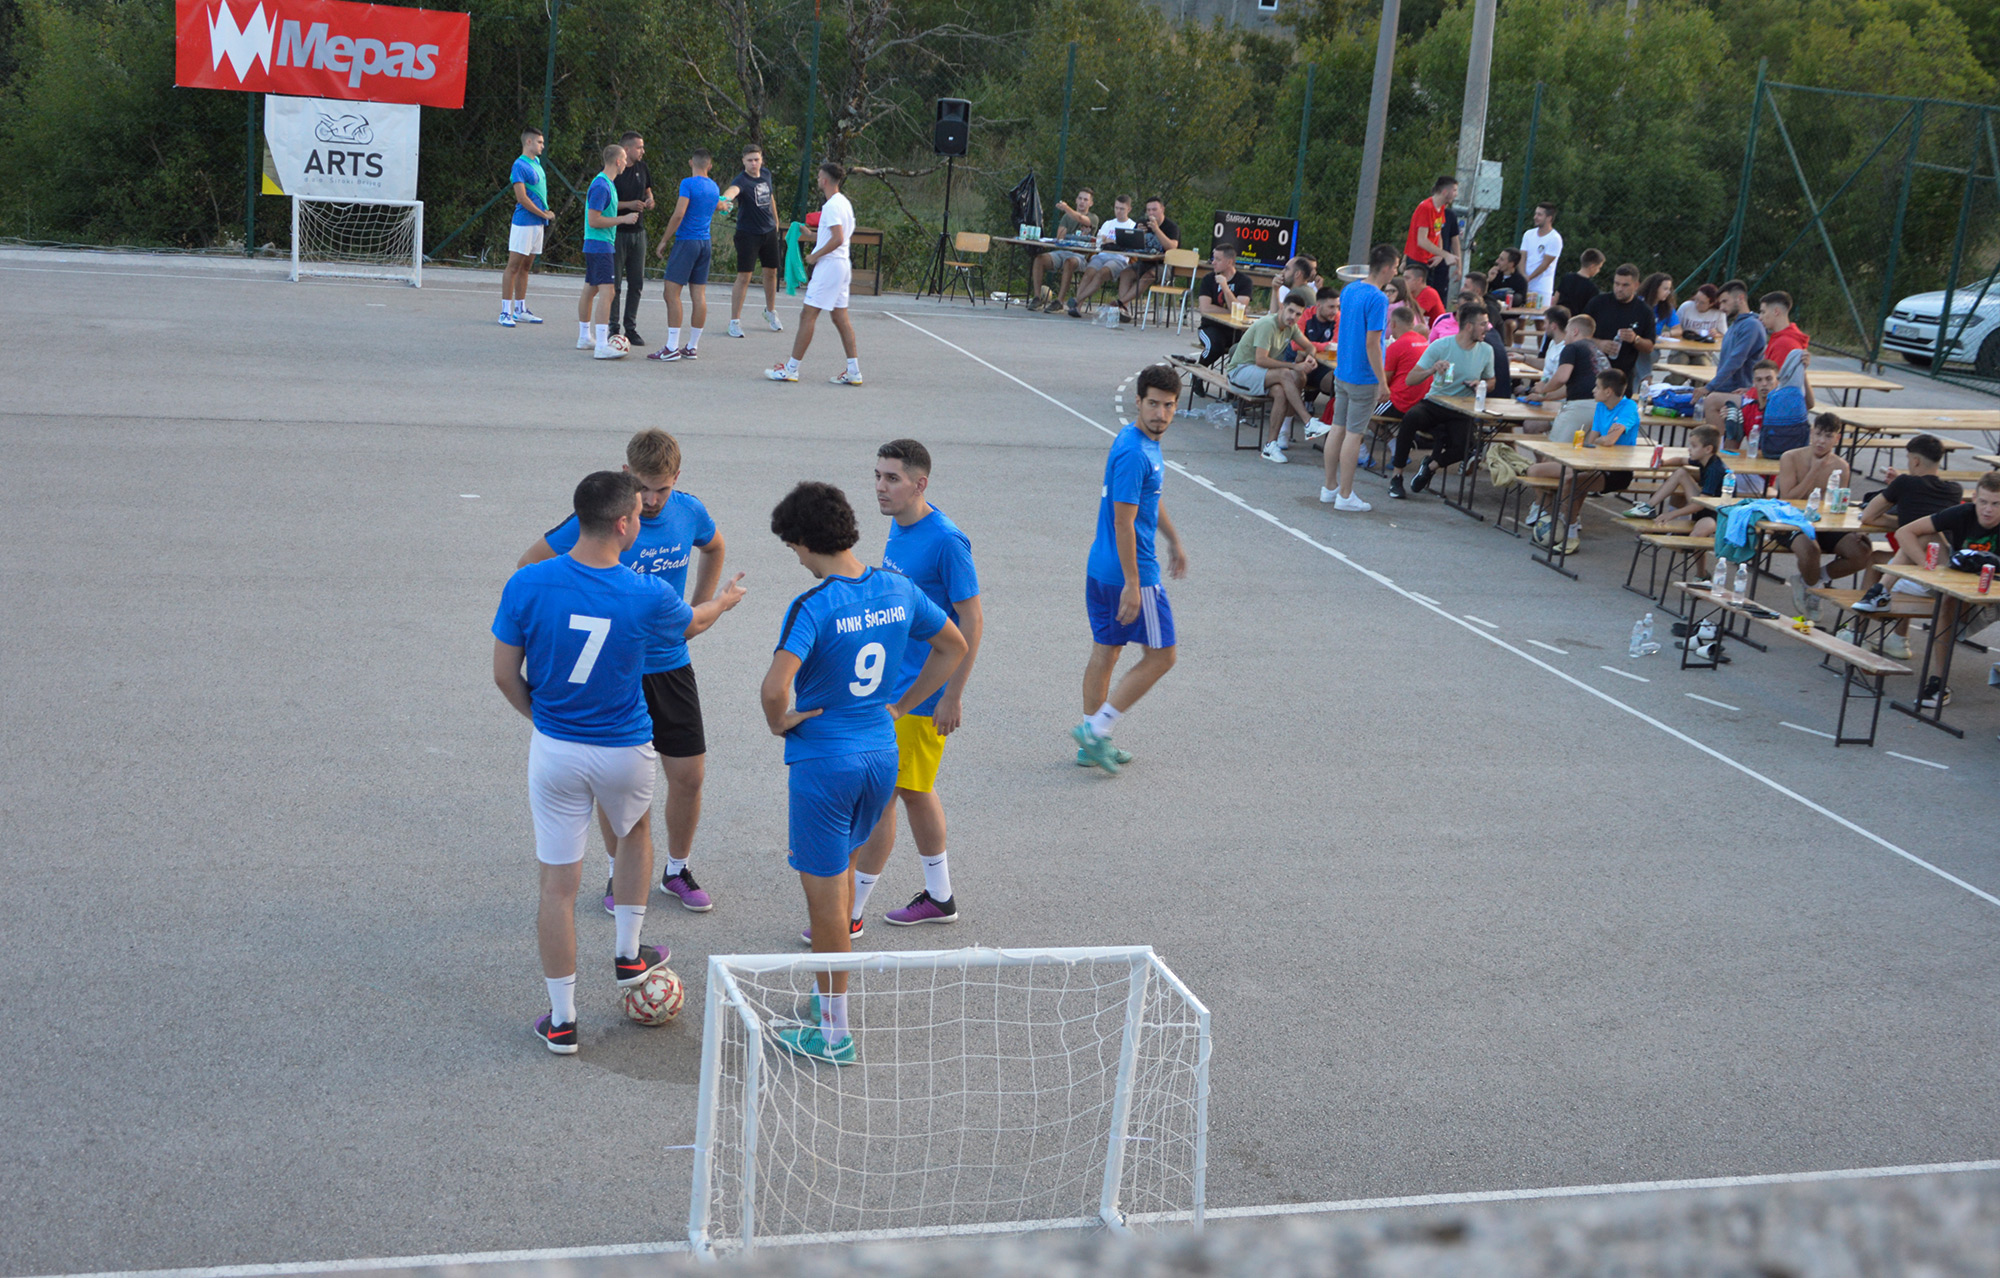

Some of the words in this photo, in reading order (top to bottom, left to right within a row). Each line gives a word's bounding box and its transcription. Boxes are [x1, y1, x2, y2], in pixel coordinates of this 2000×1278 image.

[276, 19, 439, 88] Mepas
[304, 149, 383, 178] ARTS
[1214, 223, 1224, 238] 0
[1226, 214, 1250, 224] ŠMRIKA
[1257, 218, 1280, 227] DODAJ
[1236, 227, 1269, 241] 10:00
[1278, 230, 1288, 245] 0
[836, 615, 863, 634] MNK
[864, 605, 906, 629] ŠMRIKA
[567, 614, 611, 684] 7
[849, 642, 886, 697] 9
